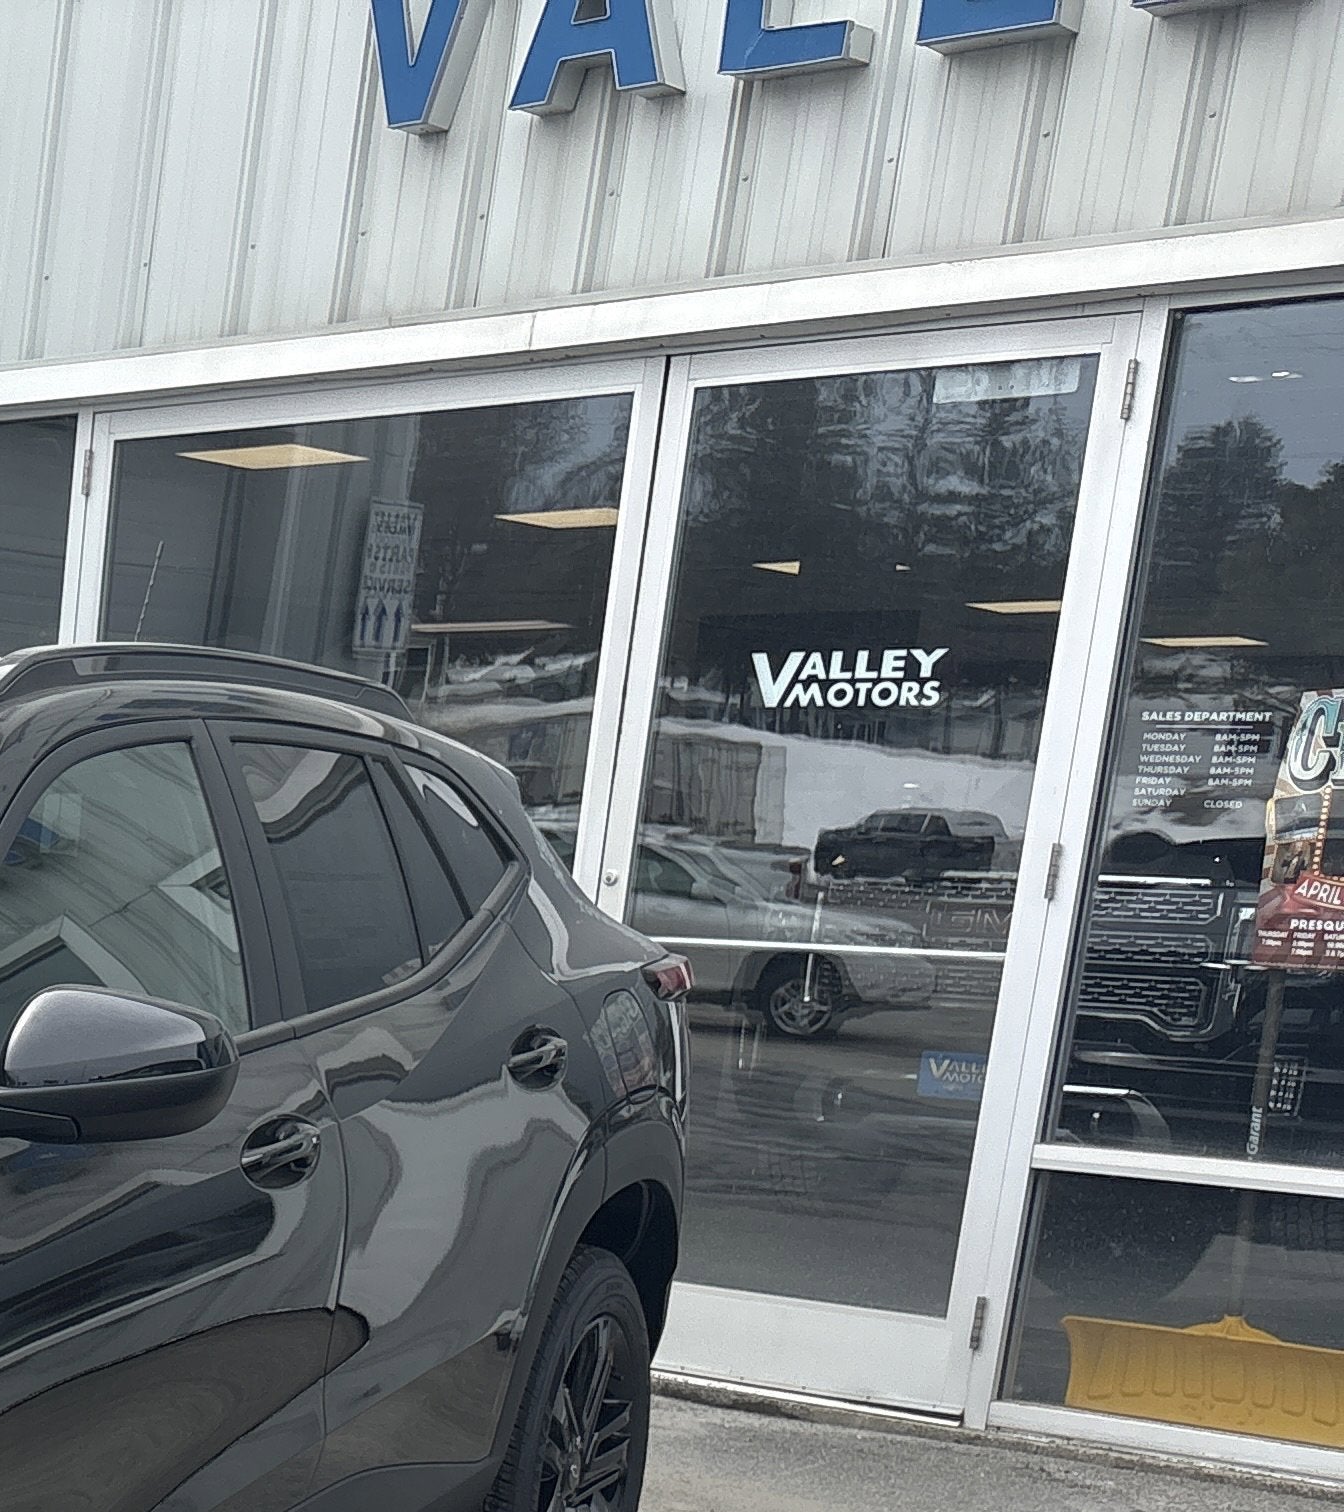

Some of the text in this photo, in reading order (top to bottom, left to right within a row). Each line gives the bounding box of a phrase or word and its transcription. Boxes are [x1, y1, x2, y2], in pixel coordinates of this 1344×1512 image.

[751, 647, 950, 708] VALLEY
[783, 680, 941, 708] MOTORS
[1141, 711, 1272, 722] SALES DEPARTMENT
[1143, 732, 1186, 741] MONDAY
[1141, 743, 1186, 752] TUESDAY
[1139, 754, 1202, 763] WEDNESDAY
[1138, 765, 1190, 774] THURSDAY
[1135, 776, 1172, 784] FRIDAY
[1134, 787, 1186, 795] SATURDAY
[1132, 798, 1243, 809] SUNDAY CLOSED
[1295, 879, 1341, 905] APRIL
[929, 1057, 986, 1079] VALL
[1246, 1105, 1263, 1155] Garant
